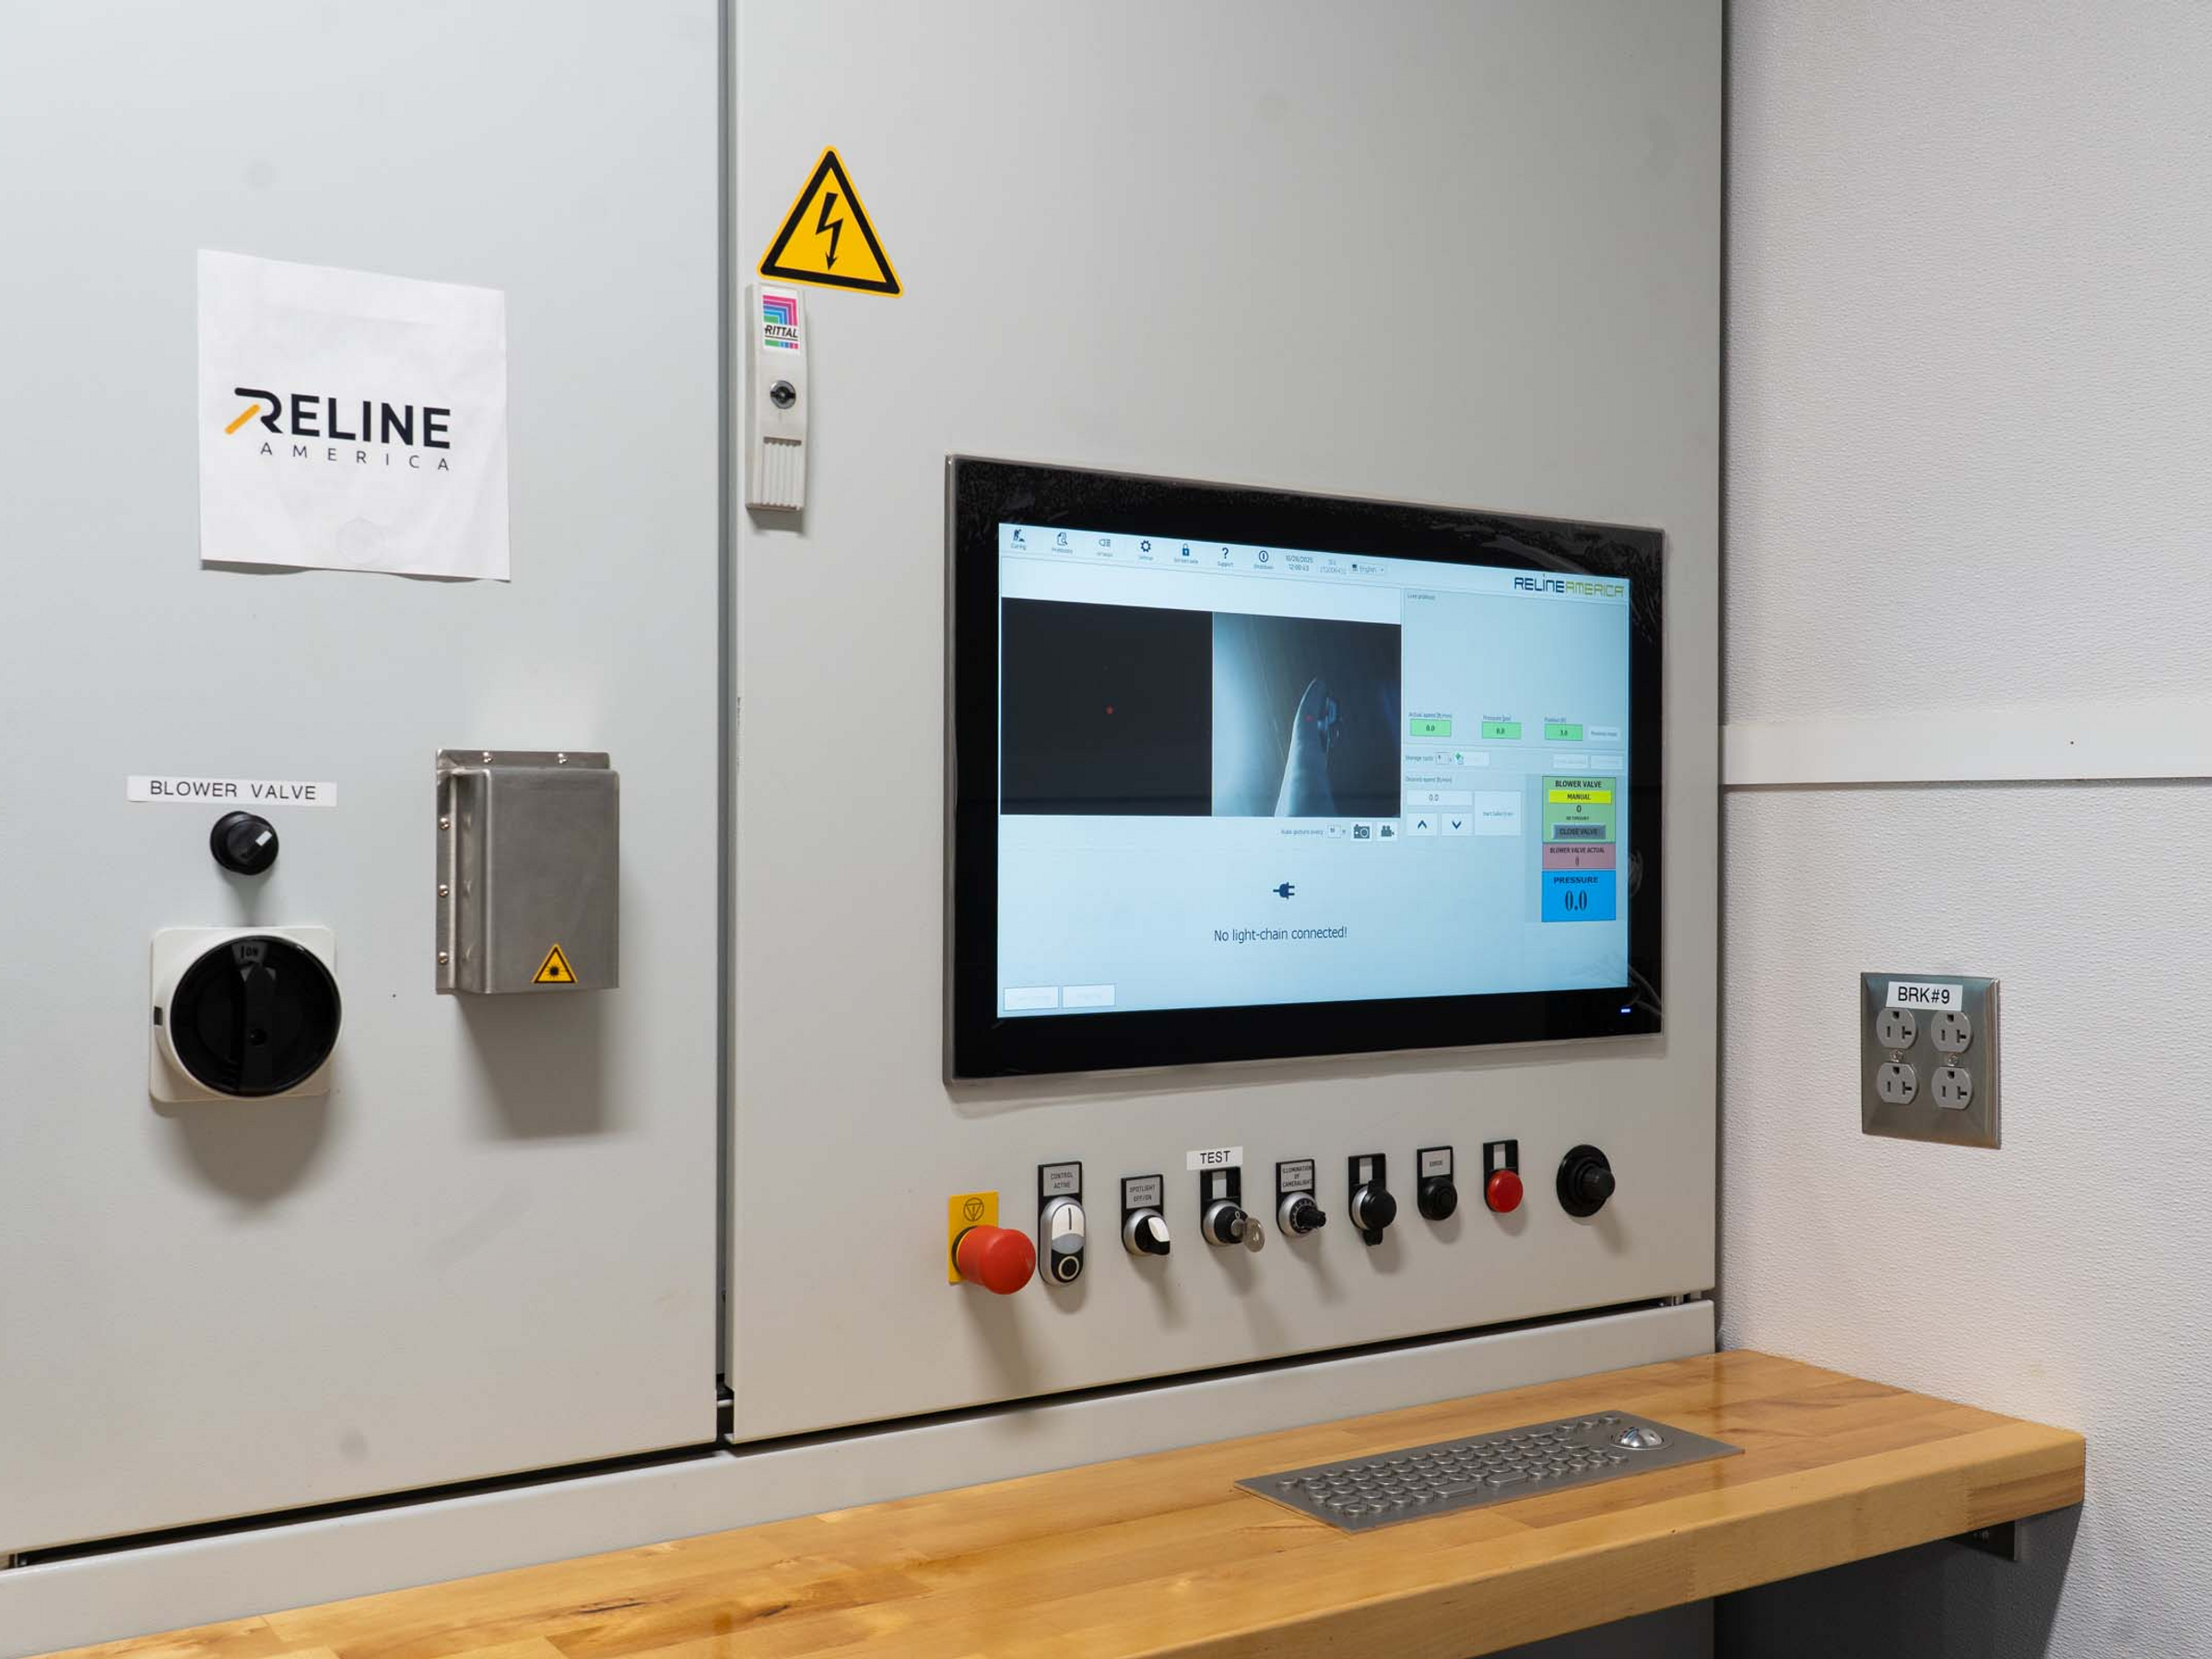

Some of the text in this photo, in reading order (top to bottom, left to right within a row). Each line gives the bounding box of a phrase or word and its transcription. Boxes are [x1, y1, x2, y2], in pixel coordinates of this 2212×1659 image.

[764, 324, 799, 338] RITTAL
[225, 386, 452, 450] RELINE
[260, 441, 450, 471] AMERICA
[150, 781, 317, 800] BLOWER VALVE
[1559, 828, 1579, 836] CLOSE
[1565, 890, 1588, 912] 0.0
[1214, 925, 1347, 944] No light-chain connected!
[1898, 986, 1950, 1005] BRK#9
[1200, 1150, 1230, 1164] TEST
[1051, 1171, 1073, 1181] CONTROL
[1053, 1182, 1071, 1190] ACTIVE
[1129, 1183, 1156, 1194] SPOTLIGHT
